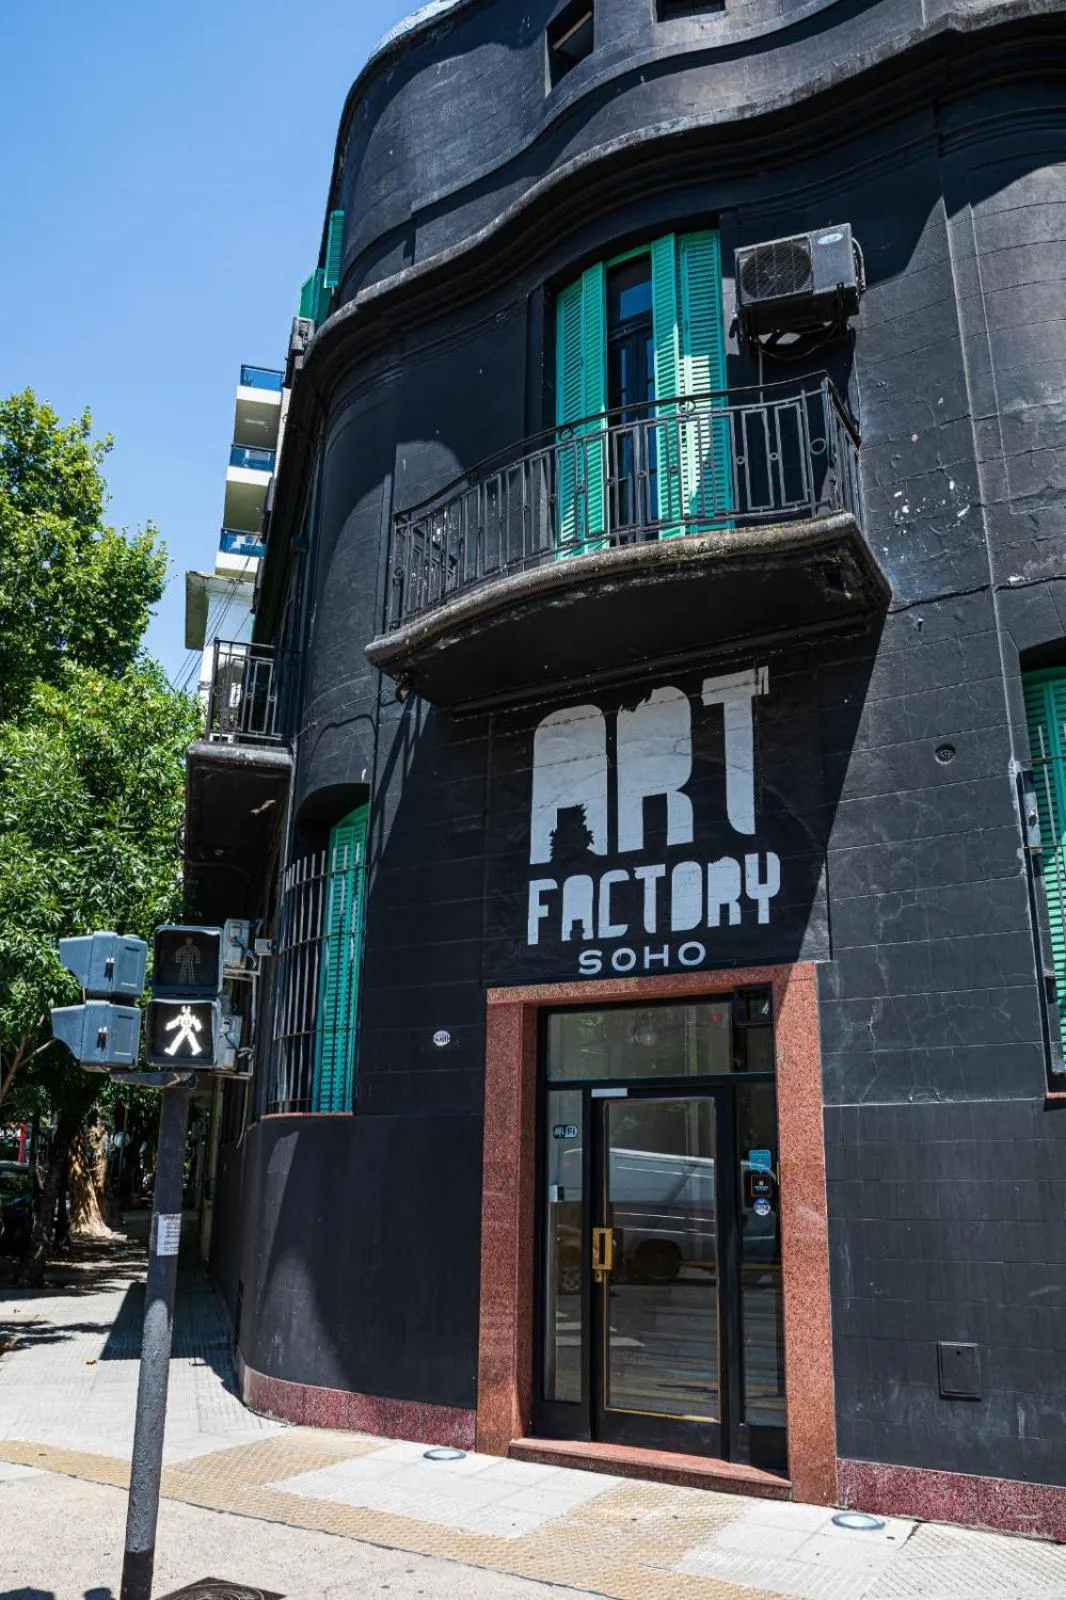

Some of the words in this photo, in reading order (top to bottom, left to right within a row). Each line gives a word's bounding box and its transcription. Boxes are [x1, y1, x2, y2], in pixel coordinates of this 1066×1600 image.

[529, 665, 770, 865] ART
[527, 851, 781, 946] FACTORY
[578, 941, 707, 975] SOHO
